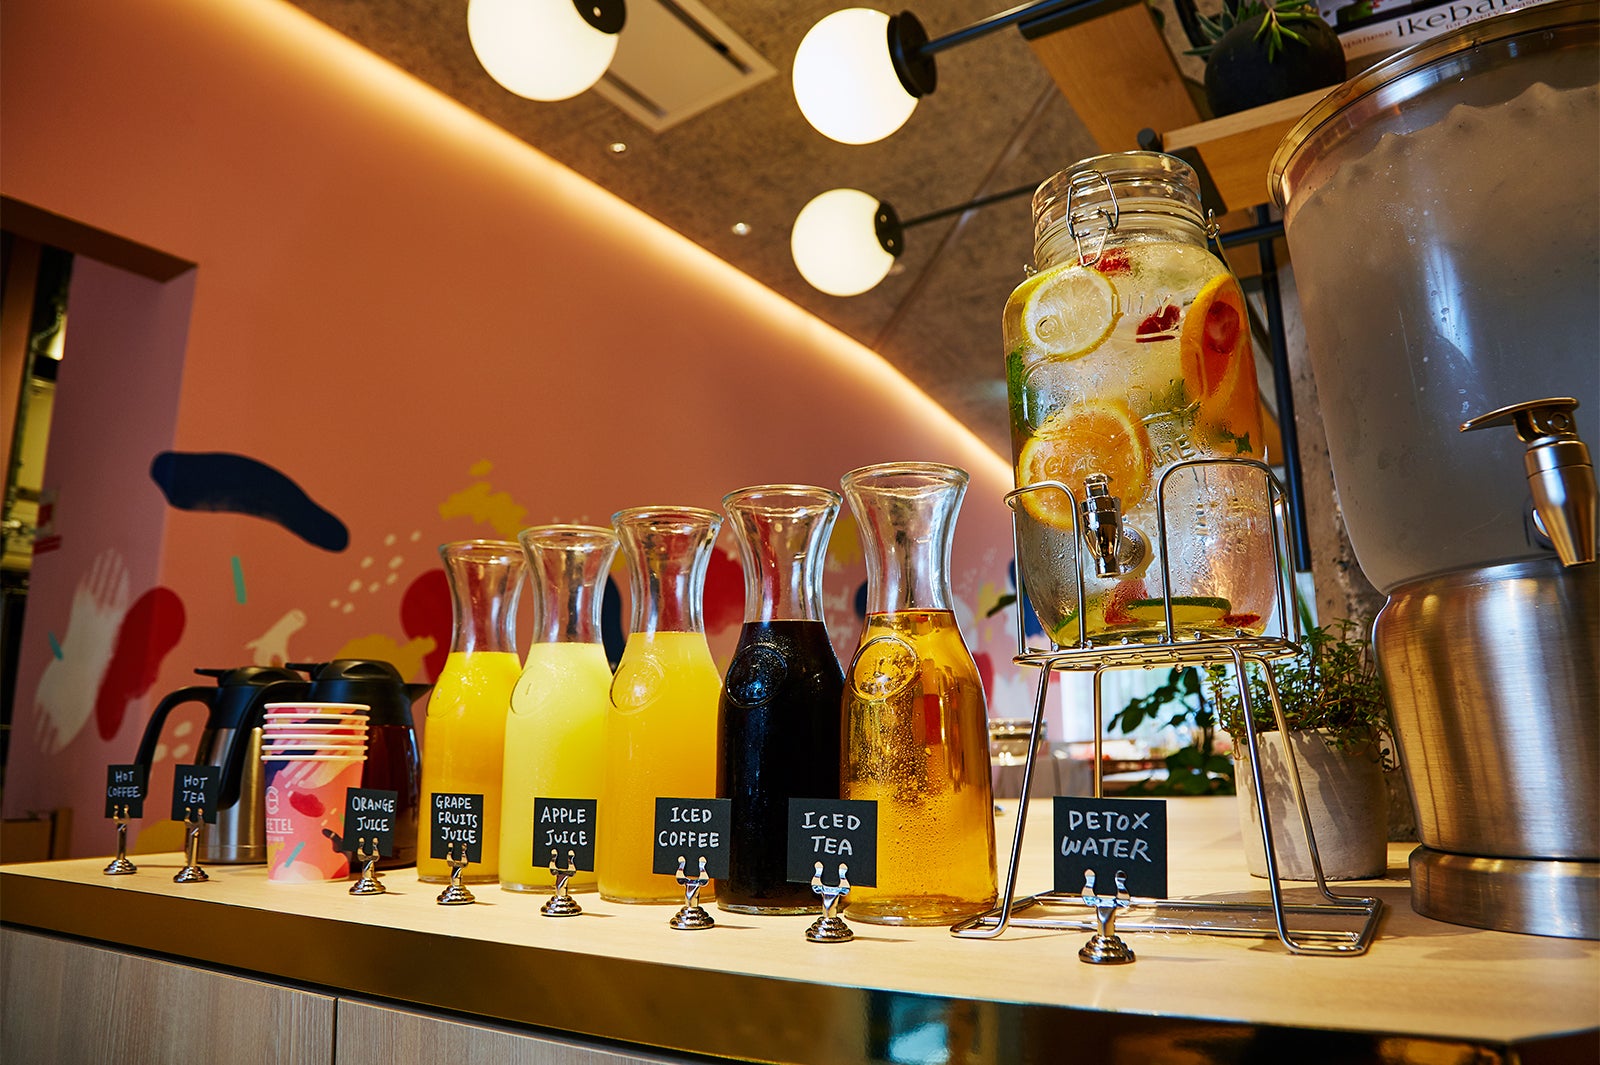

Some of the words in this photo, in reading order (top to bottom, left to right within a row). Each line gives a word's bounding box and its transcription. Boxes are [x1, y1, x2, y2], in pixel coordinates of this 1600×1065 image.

[114, 771, 135, 783] HOT
[183, 775, 209, 789] HOT
[107, 786, 141, 798] COFFEE
[182, 790, 206, 804] TEA
[352, 796, 395, 813] ORANGE
[435, 795, 472, 809] GRAPE
[438, 811, 478, 829] FRUITS
[540, 806, 586, 824] APPLE
[670, 806, 713, 823] ICED
[801, 811, 861, 831] ICED
[1068, 810, 1151, 832] DETOX
[356, 816, 390, 832] JUICE
[441, 826, 477, 844] JUICE
[545, 829, 588, 846] JUICE
[658, 830, 720, 848] COFFEE
[810, 835, 853, 856] TEA
[1061, 836, 1152, 863] WATER
